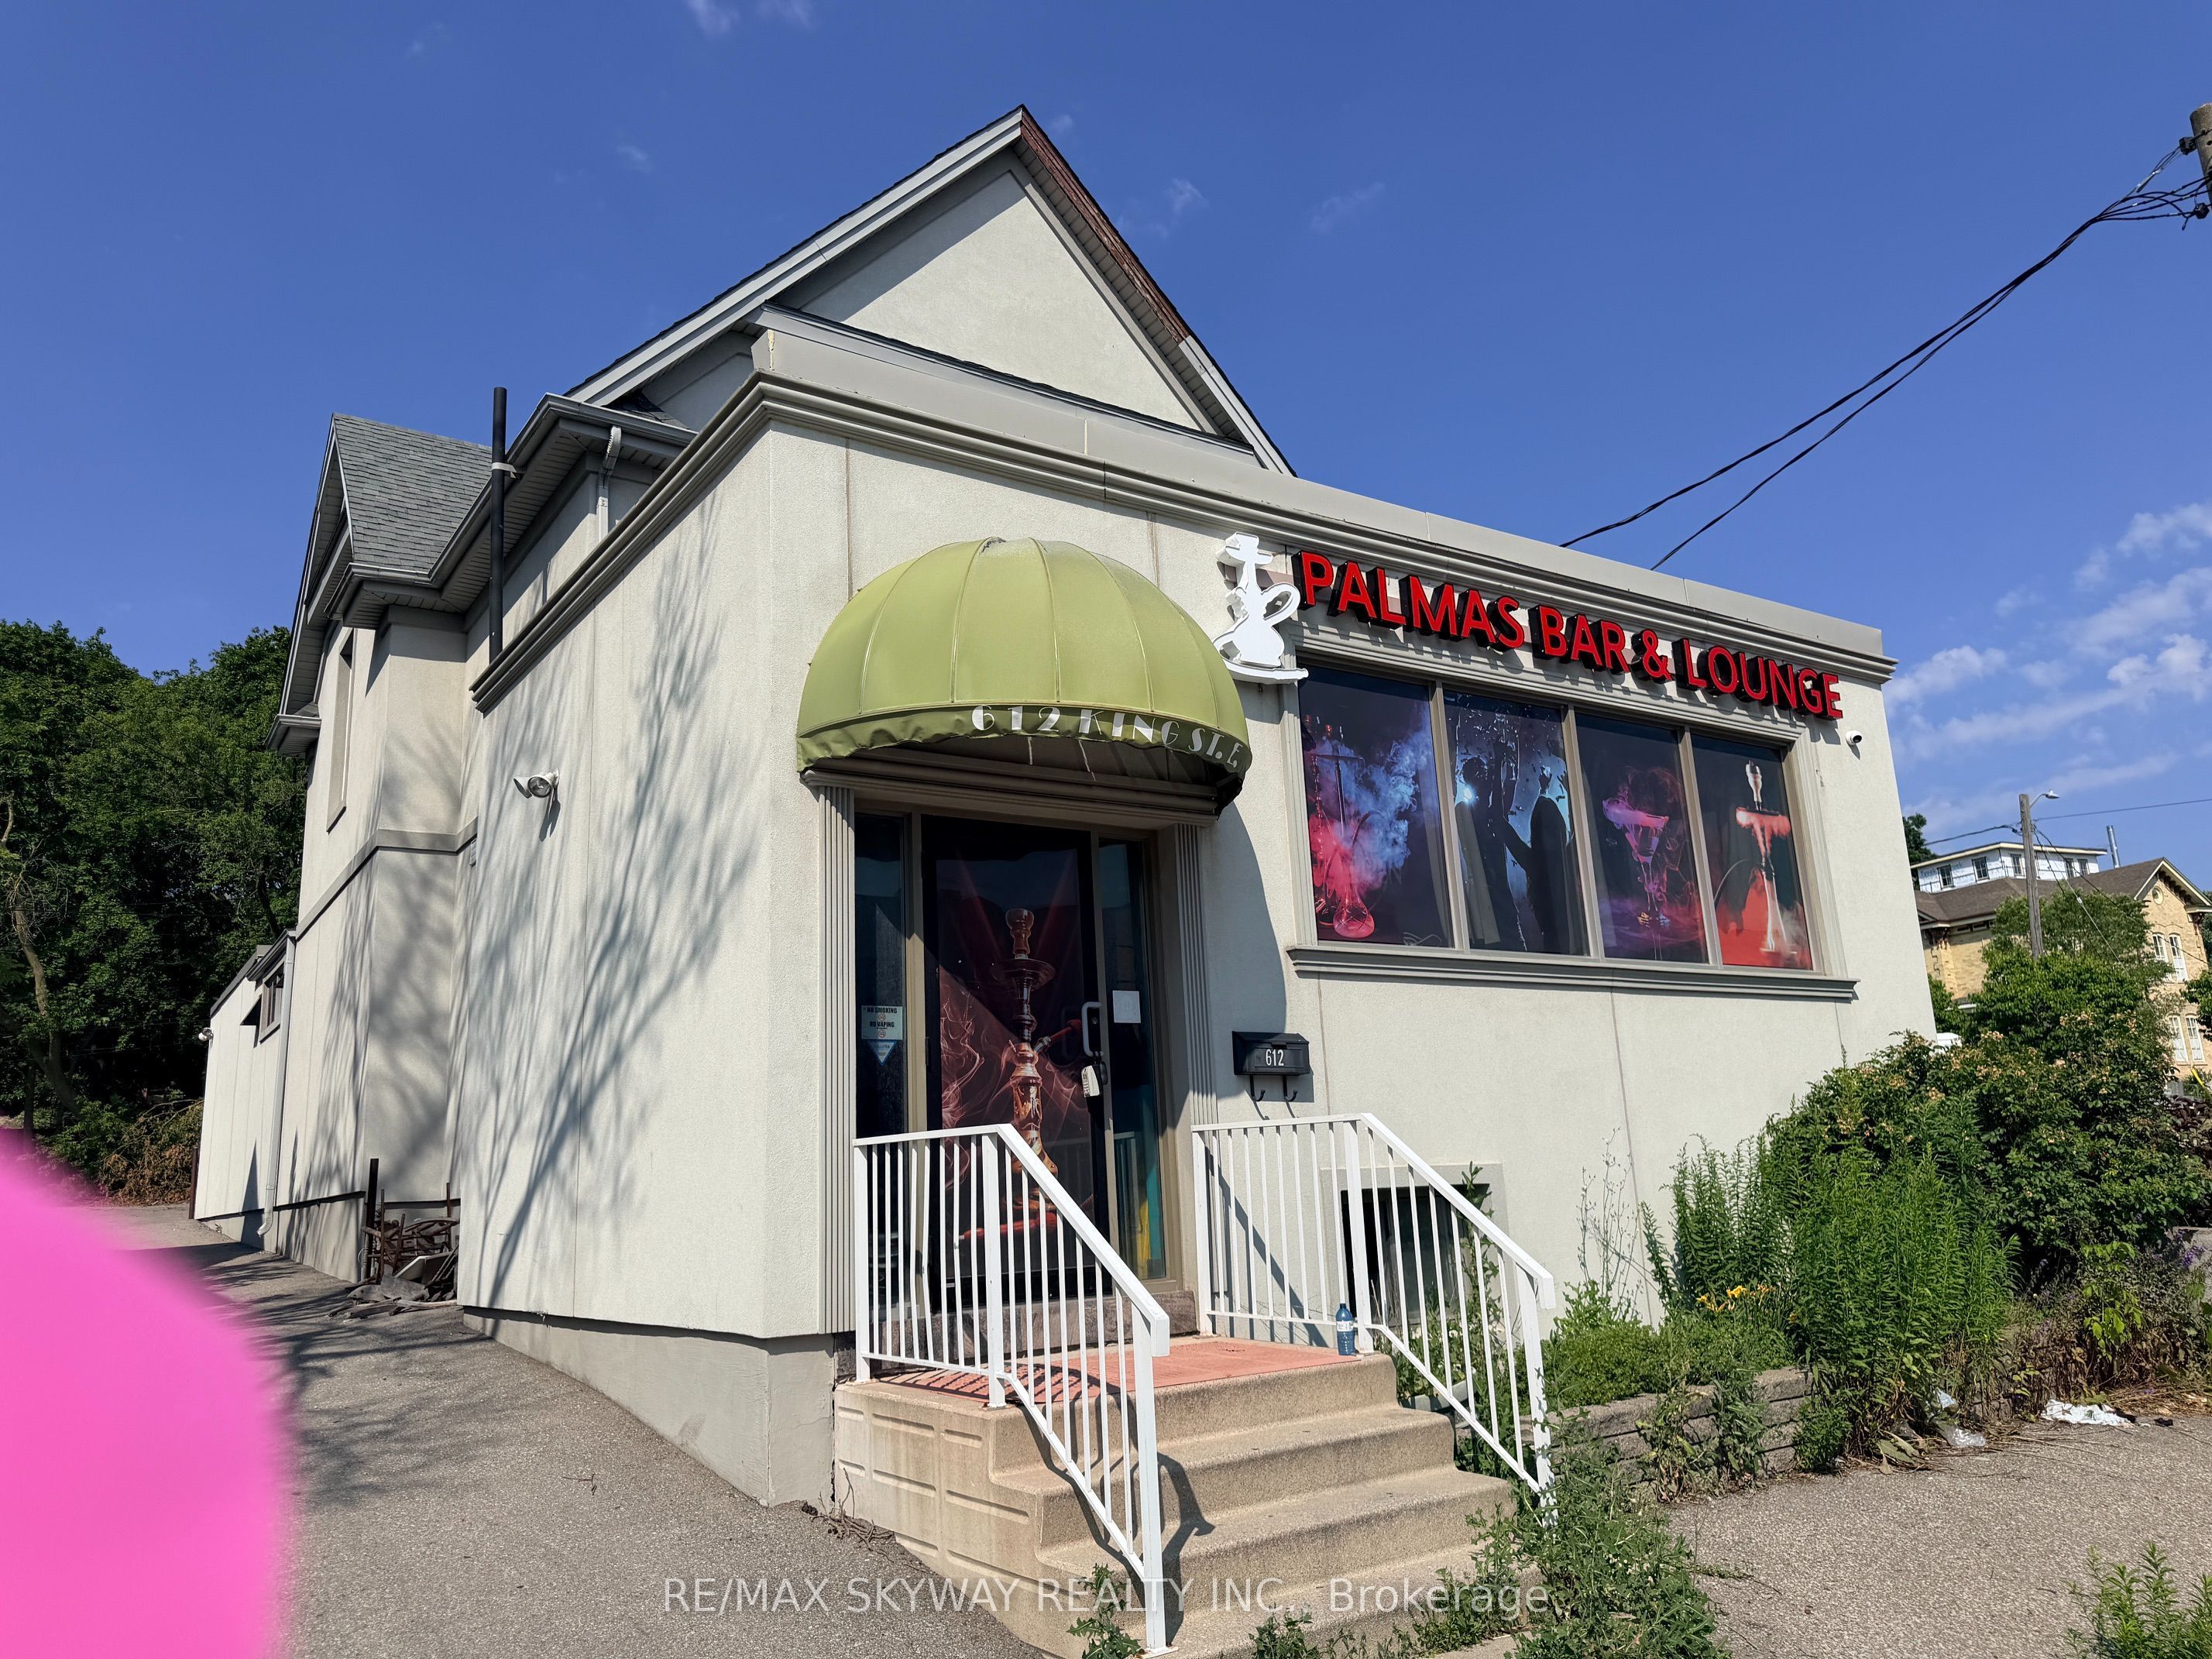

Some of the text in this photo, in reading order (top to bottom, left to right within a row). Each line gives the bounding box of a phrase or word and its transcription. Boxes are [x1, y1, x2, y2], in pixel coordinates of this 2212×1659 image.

[1294, 551, 1844, 720] PALMAS BAR & LOUNGE
[971, 704, 1243, 768] 612 KING ST. E
[1265, 1049, 1285, 1066] 612
